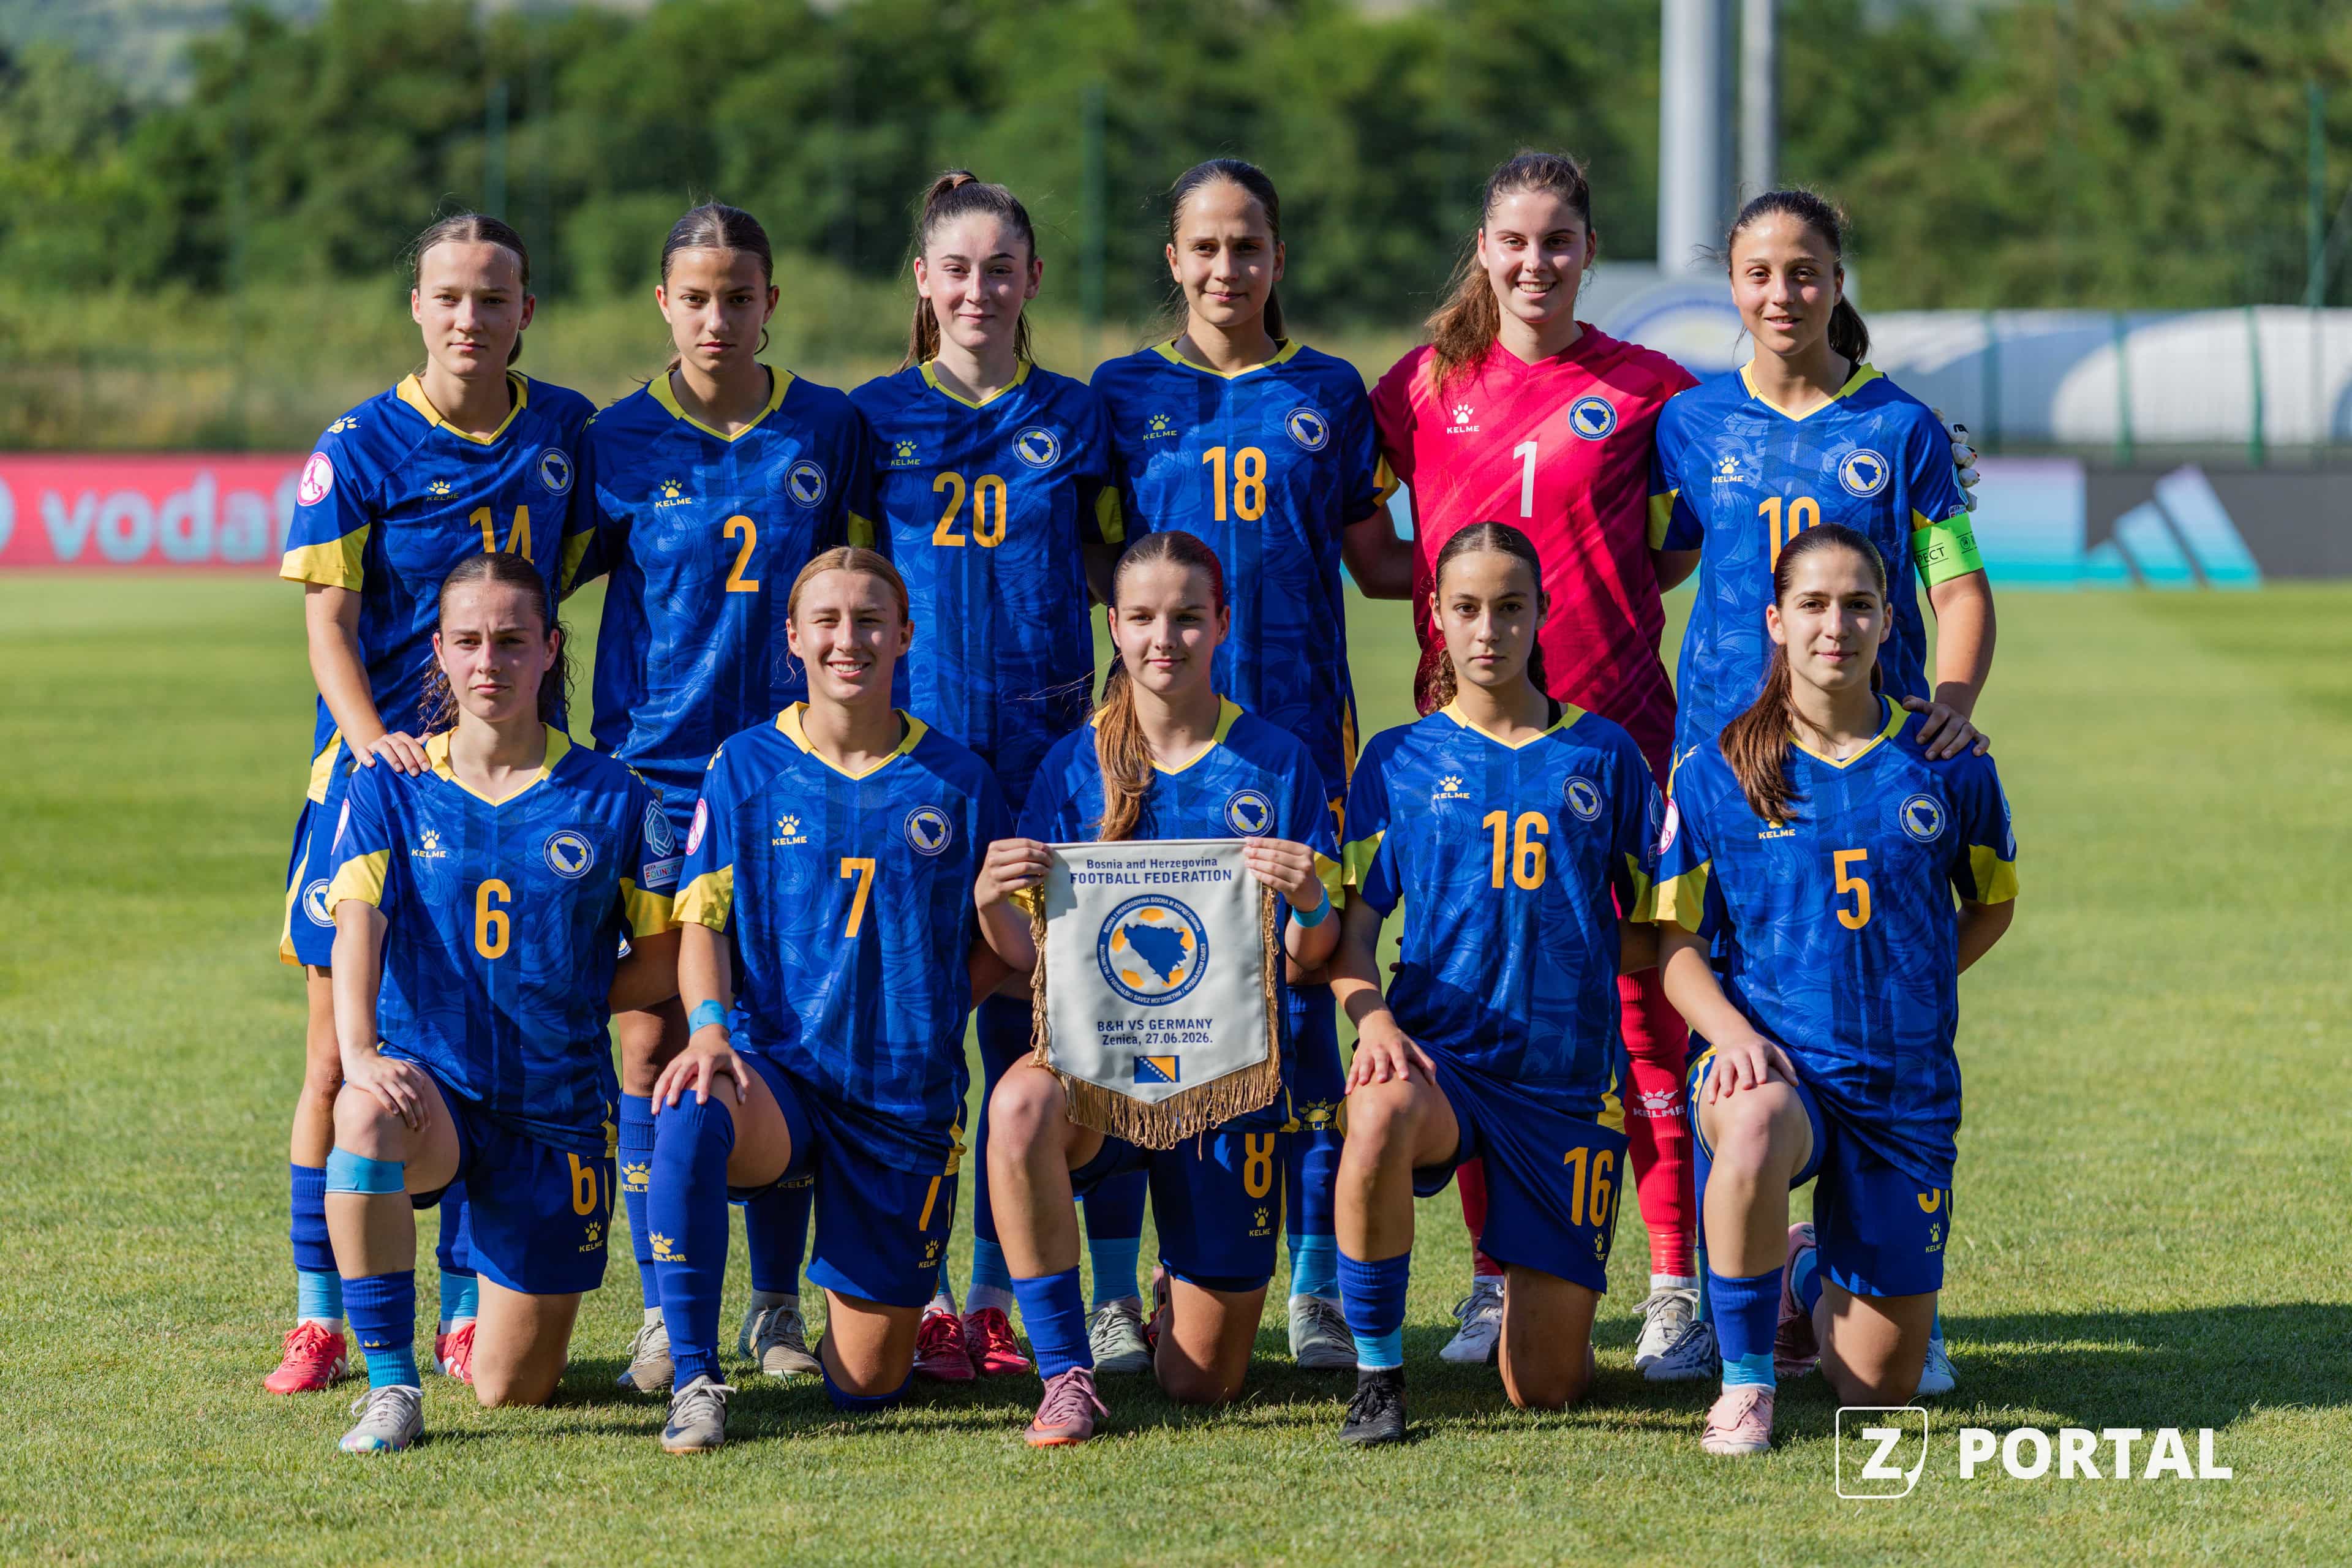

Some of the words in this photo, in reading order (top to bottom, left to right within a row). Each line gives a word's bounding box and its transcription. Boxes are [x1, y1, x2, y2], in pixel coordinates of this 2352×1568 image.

[1143, 430, 1177, 440] KELME
[1447, 425, 1480, 434] KELME
[1202, 446, 1267, 521] 18
[1513, 440, 1537, 518] 1
[1712, 475, 1744, 483] KELME
[426, 492, 459, 502] KELME
[655, 497, 692, 508] KELME
[932, 471, 1007, 548] 20
[470, 505, 534, 565] 14
[723, 515, 760, 592] 2
[772, 835, 807, 846] KELME
[1758, 829, 1795, 840] KELME
[411, 849, 447, 858] KELME
[1482, 810, 1549, 890] 16
[1087, 859, 1123, 869] Bosnia
[1126, 859, 1145, 869] and
[1150, 857, 1218, 871] Herzegovina
[1070, 872, 1140, 884] FOOTBALL
[1145, 870, 1232, 884] FEDERATION
[1833, 848, 1871, 930] 5
[841, 858, 876, 938] 7
[475, 878, 511, 959] 6
[1098, 1020, 1124, 1031] B&H
[1128, 1020, 1144, 1030] VS
[1149, 1019, 1213, 1030] GERMANY
[1102, 1035, 1142, 1047] Zenica,
[1145, 1033, 1213, 1044] 27.06.2026.
[1633, 1105, 1685, 1118] KELME
[1244, 1133, 1275, 1199] 8
[1564, 1147, 1614, 1227] 16
[1249, 1228, 1271, 1237] KELME
